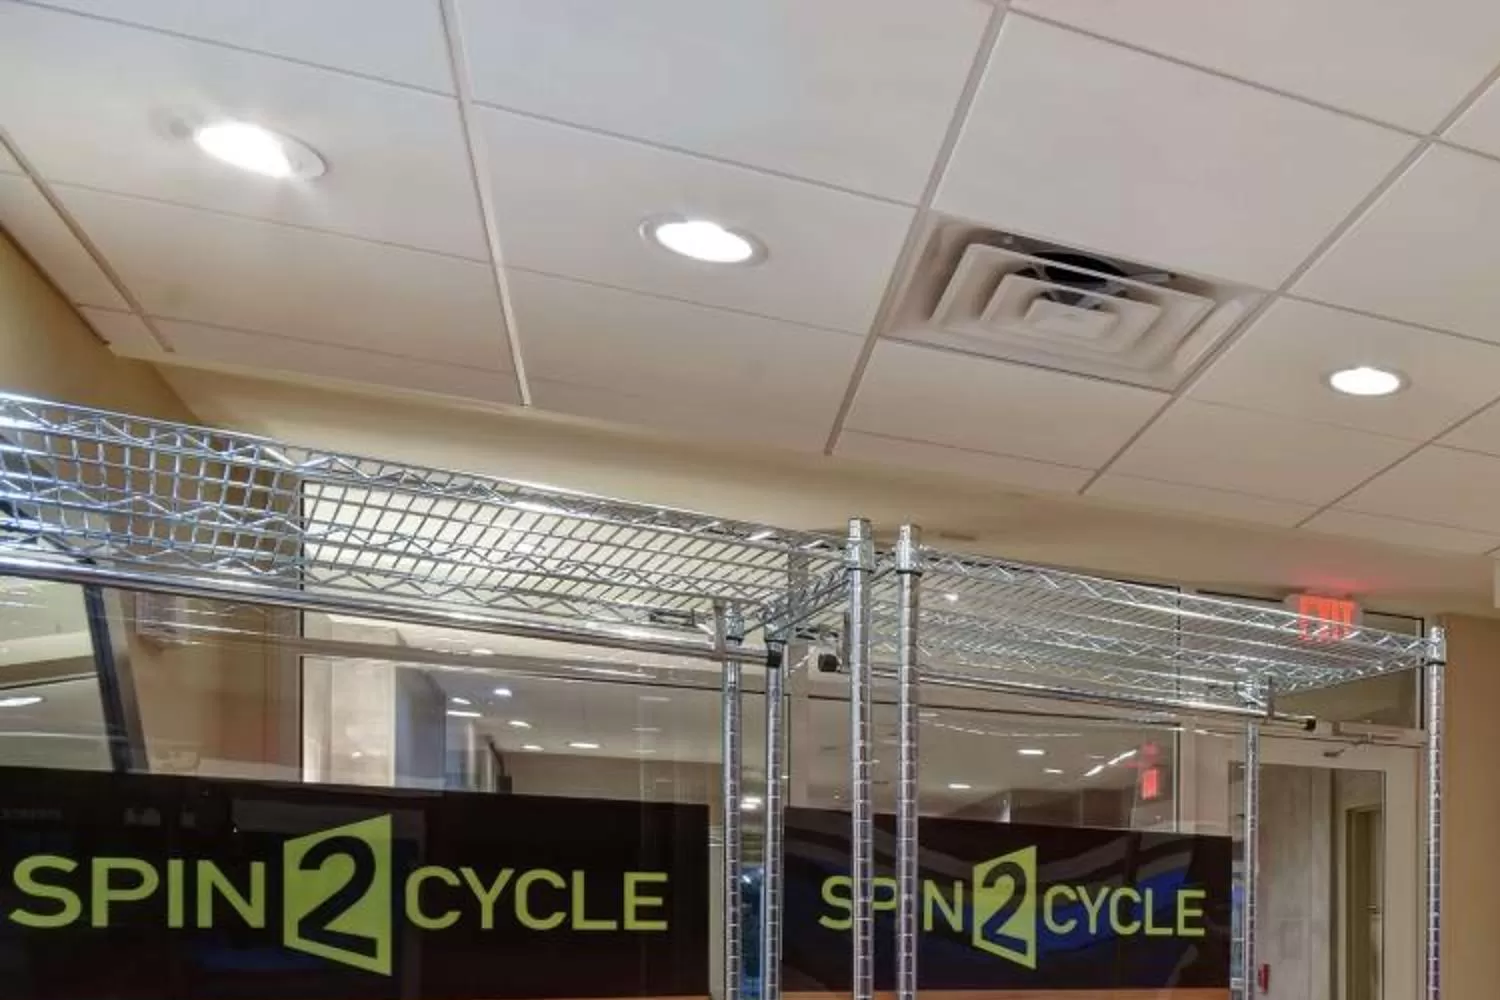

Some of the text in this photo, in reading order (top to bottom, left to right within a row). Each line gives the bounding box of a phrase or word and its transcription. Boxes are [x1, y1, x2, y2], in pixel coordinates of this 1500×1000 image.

[8, 834, 669, 959] SPIN 2 CYCLE
[818, 860, 1207, 956] SPN 2 CYCLE
